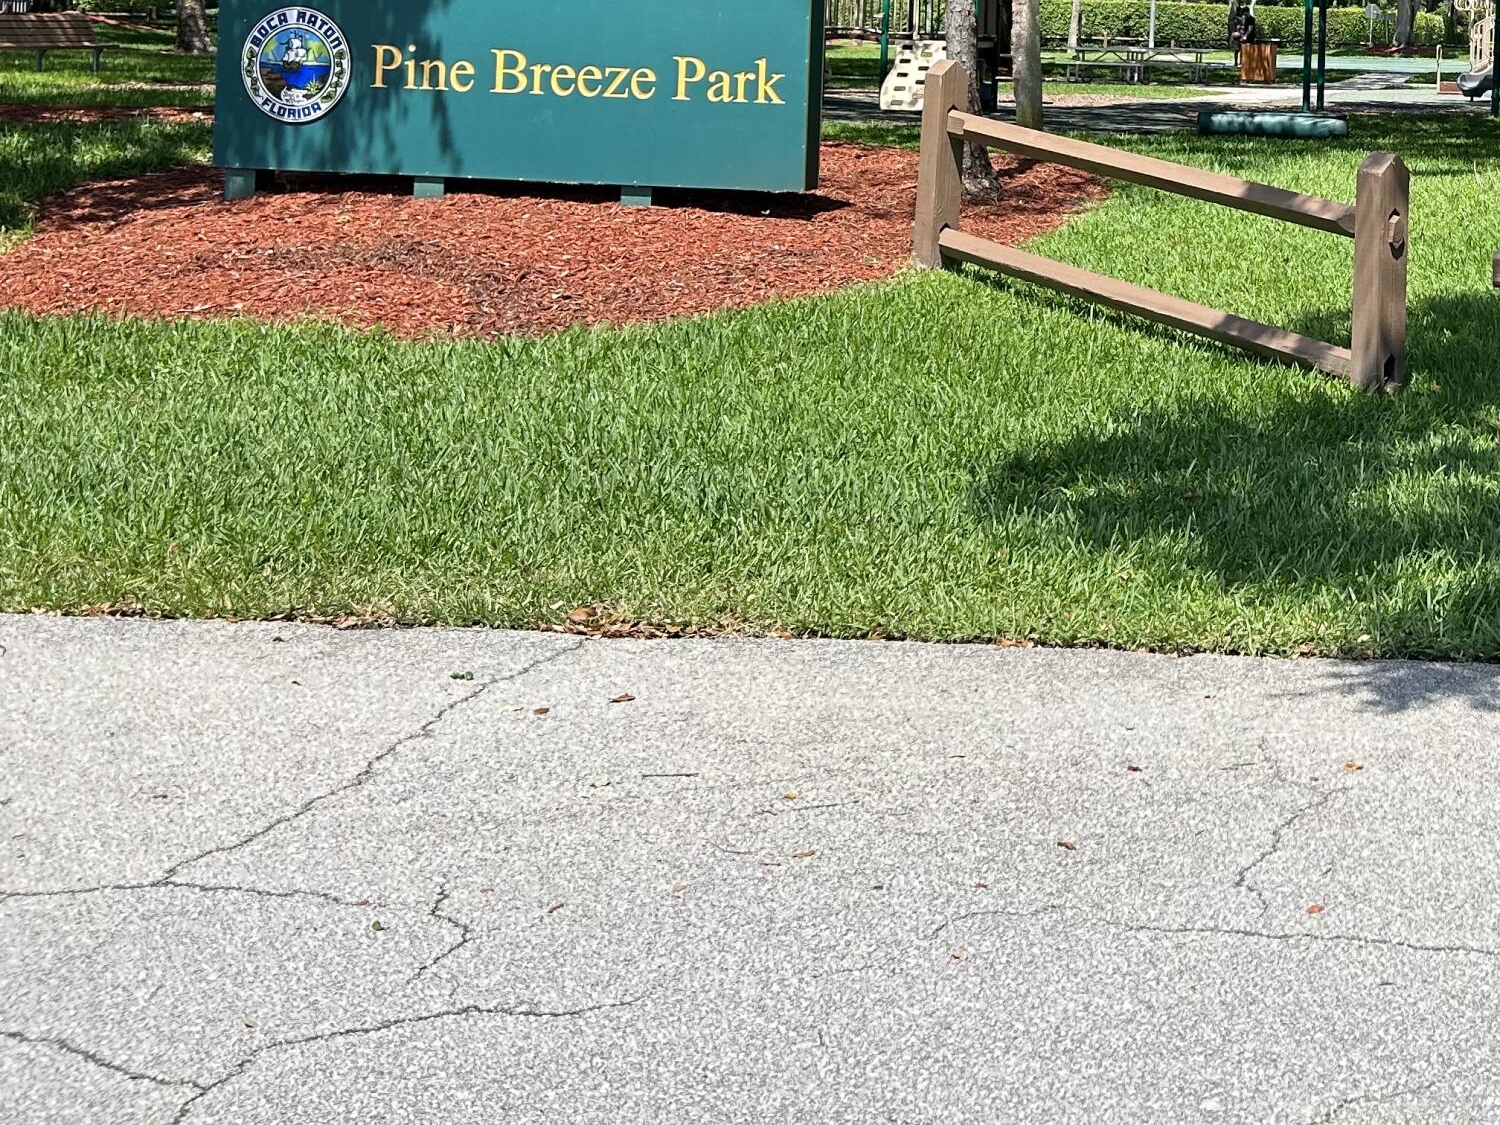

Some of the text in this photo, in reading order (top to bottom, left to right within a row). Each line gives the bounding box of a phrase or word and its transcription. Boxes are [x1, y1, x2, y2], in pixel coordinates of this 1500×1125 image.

[250, 11, 343, 50] BOCA RATON
[370, 44, 786, 104] Pine Breeze Park
[261, 97, 322, 118] FLORIDA
